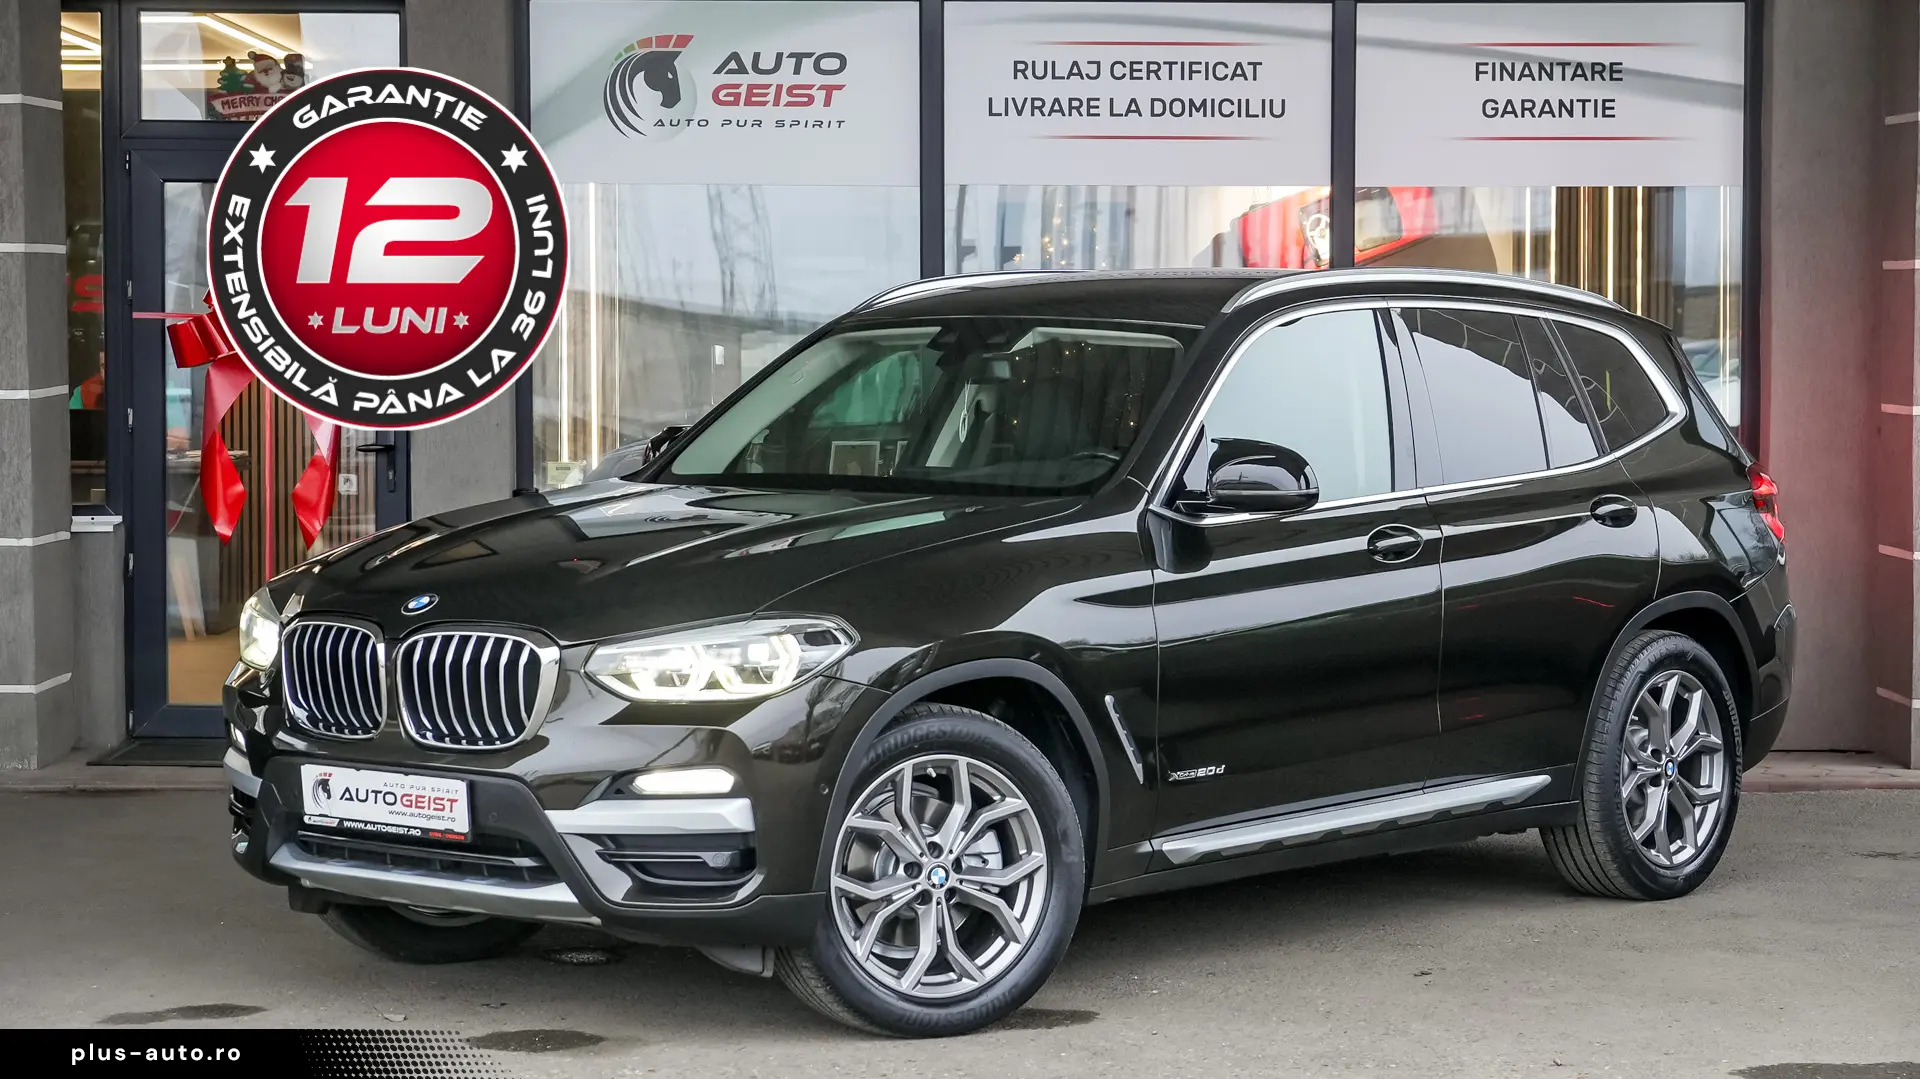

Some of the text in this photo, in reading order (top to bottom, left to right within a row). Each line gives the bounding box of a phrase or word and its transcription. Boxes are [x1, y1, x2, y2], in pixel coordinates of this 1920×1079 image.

[712, 51, 848, 76] AUTO
[1012, 60, 1263, 82] RULAJ CERTIFICAT
[1475, 62, 1624, 82] FINANTARE
[221, 96, 261, 110] MERRY
[711, 83, 848, 108] GEIST
[987, 97, 1286, 119] LIVRARE LA DOMICILIU
[1482, 98, 1616, 118] GARANTIE
[653, 118, 846, 129] AUTO PUR SPIRIT
[431, 786, 459, 795] SPIRIT
[388, 809, 456, 823] www.autogeist.ro
[343, 820, 422, 837] WWW.AUTOGEIST.RO
